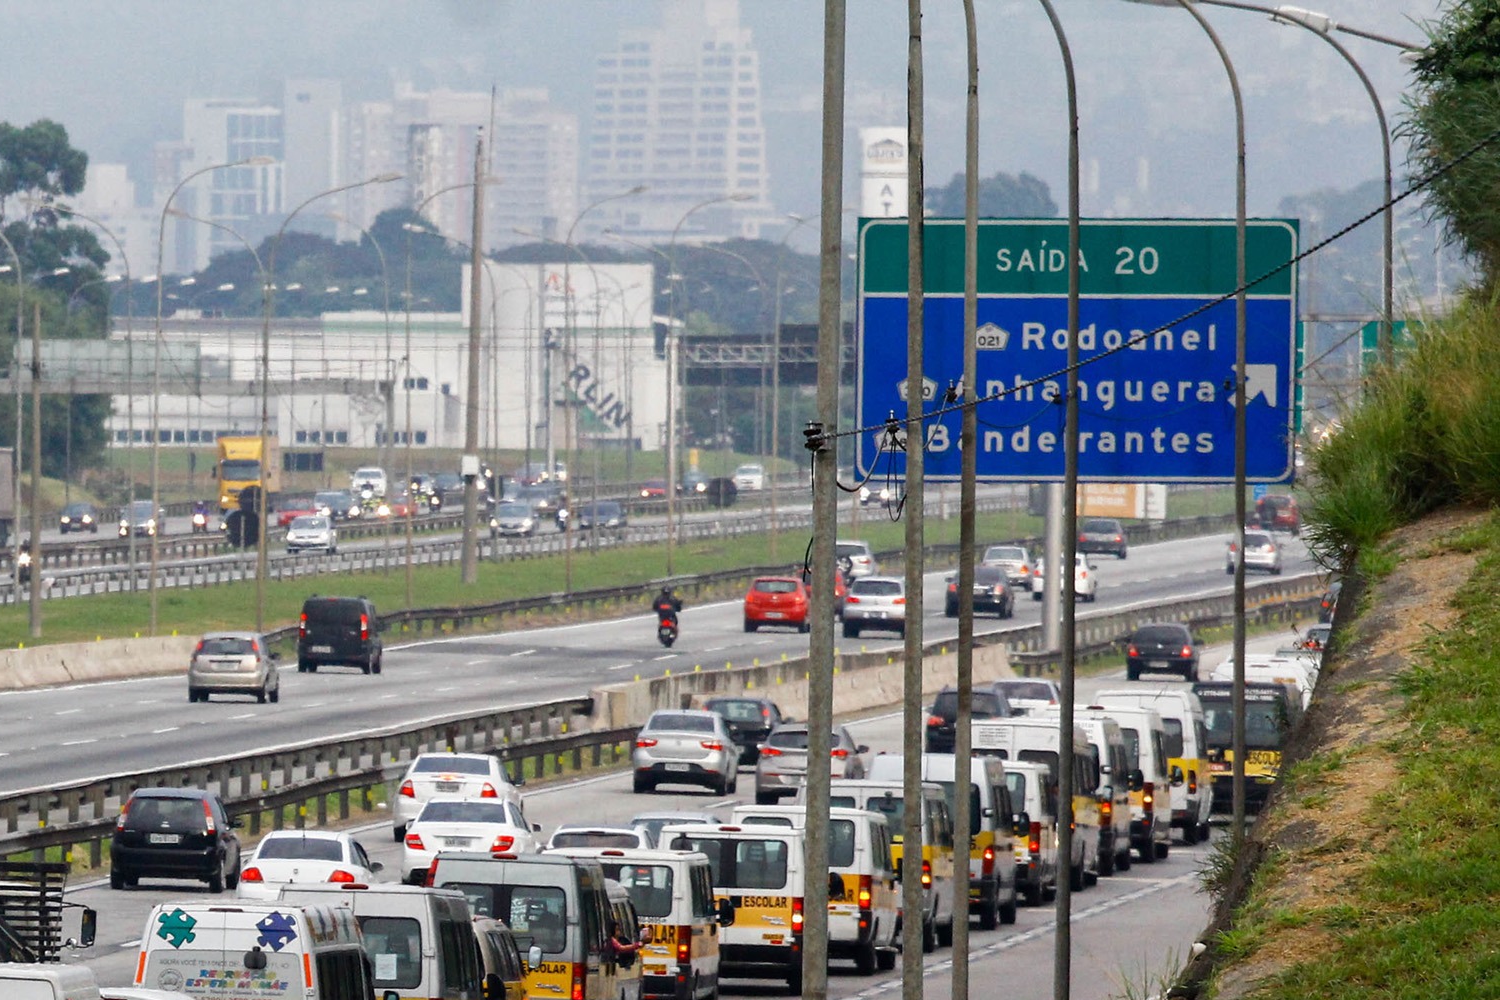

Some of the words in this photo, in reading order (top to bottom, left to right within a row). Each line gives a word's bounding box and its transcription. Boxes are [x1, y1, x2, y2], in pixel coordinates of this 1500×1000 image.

[1115, 246, 1160, 275] 20
[978, 336, 1000, 347] 021
[1022, 322, 1217, 351] Rodoanel
[743, 896, 787, 908] ESCOLAR
